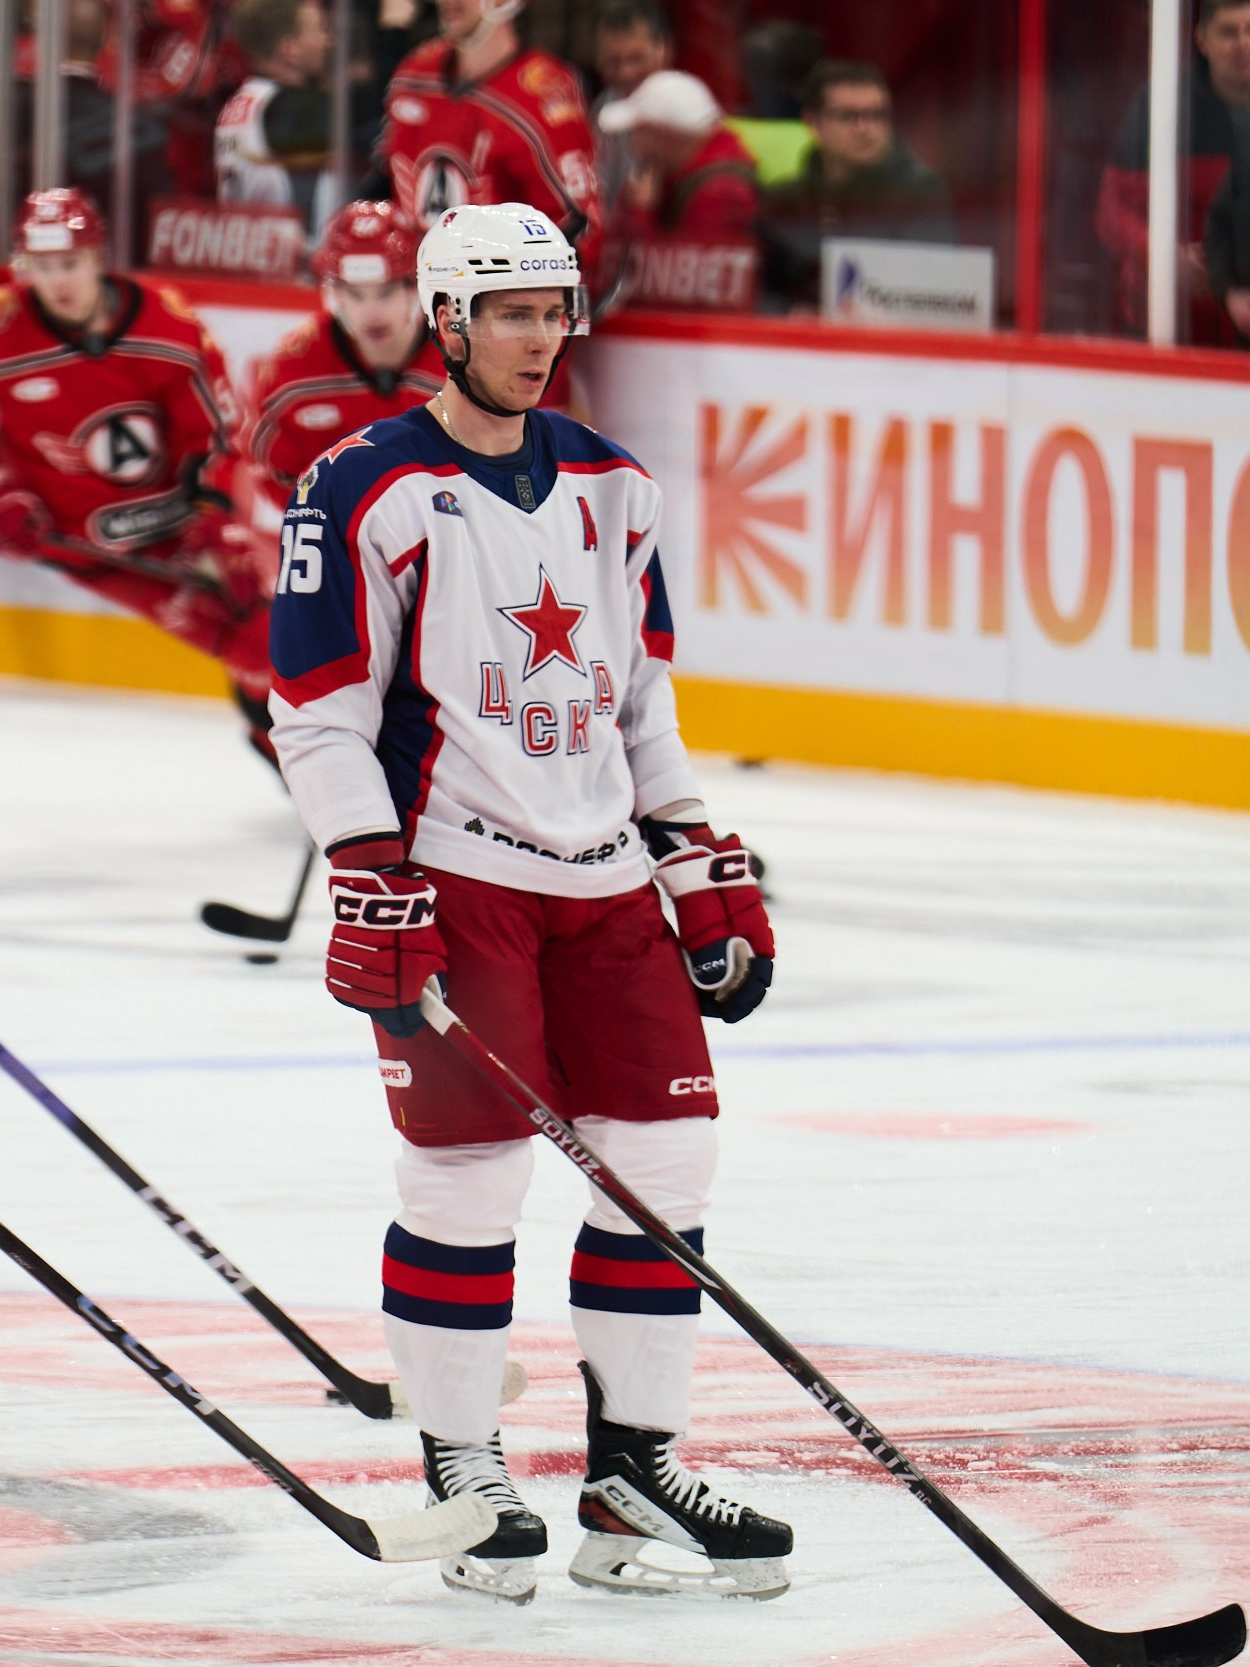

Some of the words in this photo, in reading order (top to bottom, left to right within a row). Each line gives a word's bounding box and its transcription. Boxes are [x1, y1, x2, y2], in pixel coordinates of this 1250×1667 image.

[150, 207, 306, 276] FONBET
[518, 218, 548, 237] 15
[519, 257, 568, 272] согаз
[576, 496, 598, 552] A
[698, 399, 1250, 662] КИНОП
[277, 523, 324, 595] 15
[478, 660, 614, 757] ЦСКА
[334, 895, 438, 926] CCM
[528, 1106, 602, 1176] SOYUZ
[806, 1380, 922, 1490] SOYUZ
[605, 1483, 665, 1533] CCM
